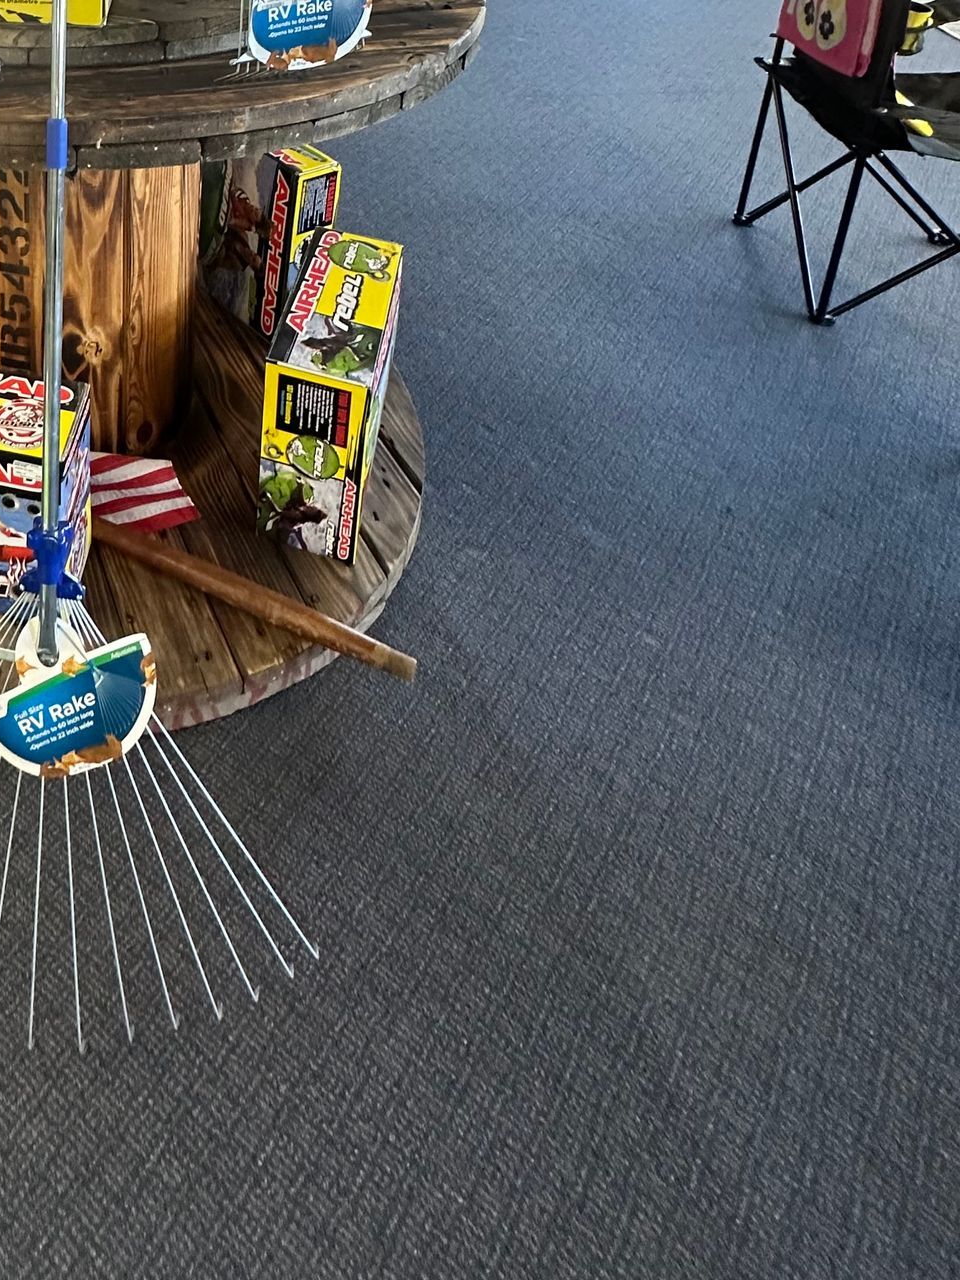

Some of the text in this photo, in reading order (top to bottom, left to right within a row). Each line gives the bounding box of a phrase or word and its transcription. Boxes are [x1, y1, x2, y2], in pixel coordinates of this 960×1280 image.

[268, 0, 333, 22] RV Rake
[261, 174, 289, 336] AIRHEAD
[287, 231, 341, 334] AIRHEAD
[337, 478, 357, 559] AIRHEAD
[14, 709, 28, 722] Full
[29, 703, 44, 717] Size
[17, 692, 96, 736] RV Rake
[57, 721, 66, 731] 60
[67, 716, 79, 728] inch
[79, 710, 94, 725] long
[66, 726, 78, 737] inch
[79, 720, 94, 733] wide
